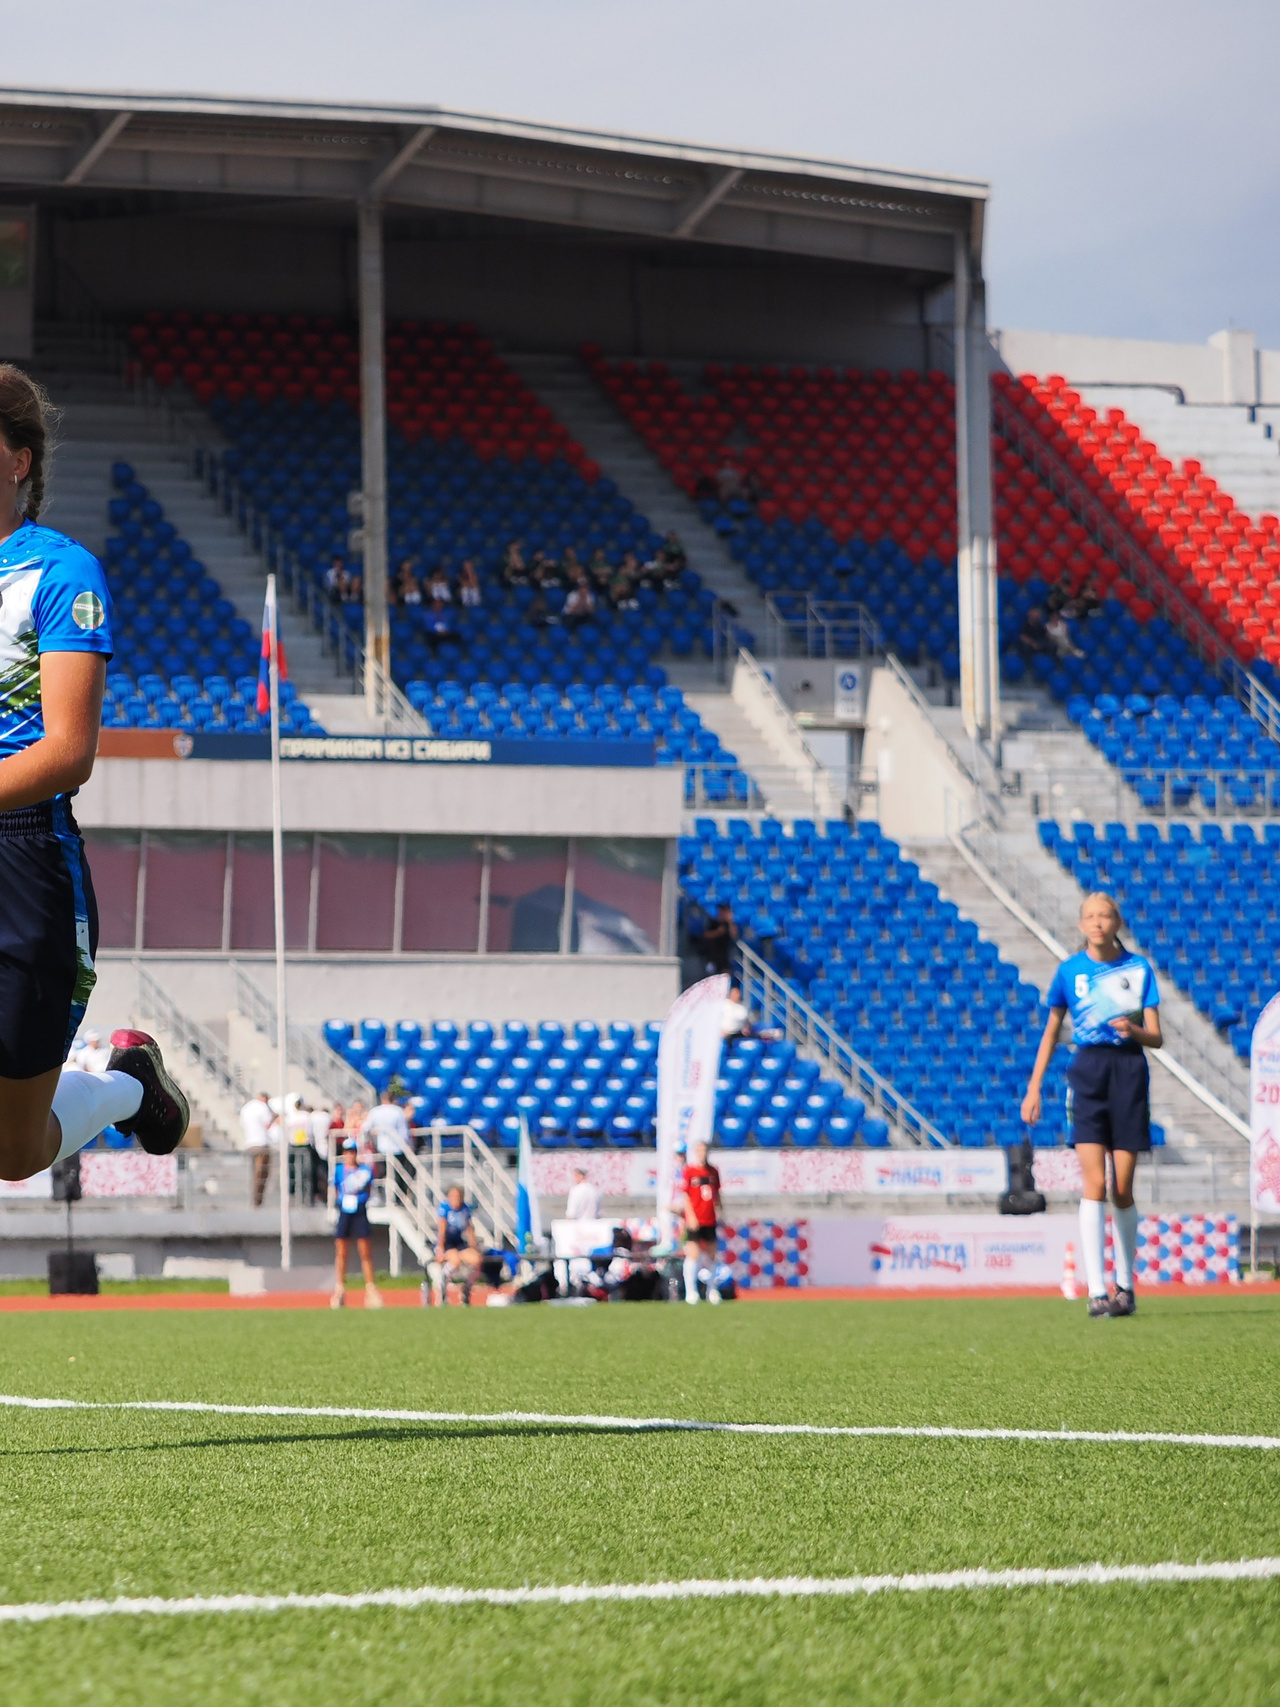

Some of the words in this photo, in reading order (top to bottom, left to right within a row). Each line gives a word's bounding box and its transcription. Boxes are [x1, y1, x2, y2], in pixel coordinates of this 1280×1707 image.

[384, 739, 411, 761] ИЗ
[412, 740, 492, 762] СИБИРИ
[1074, 973, 1089, 999] 5
